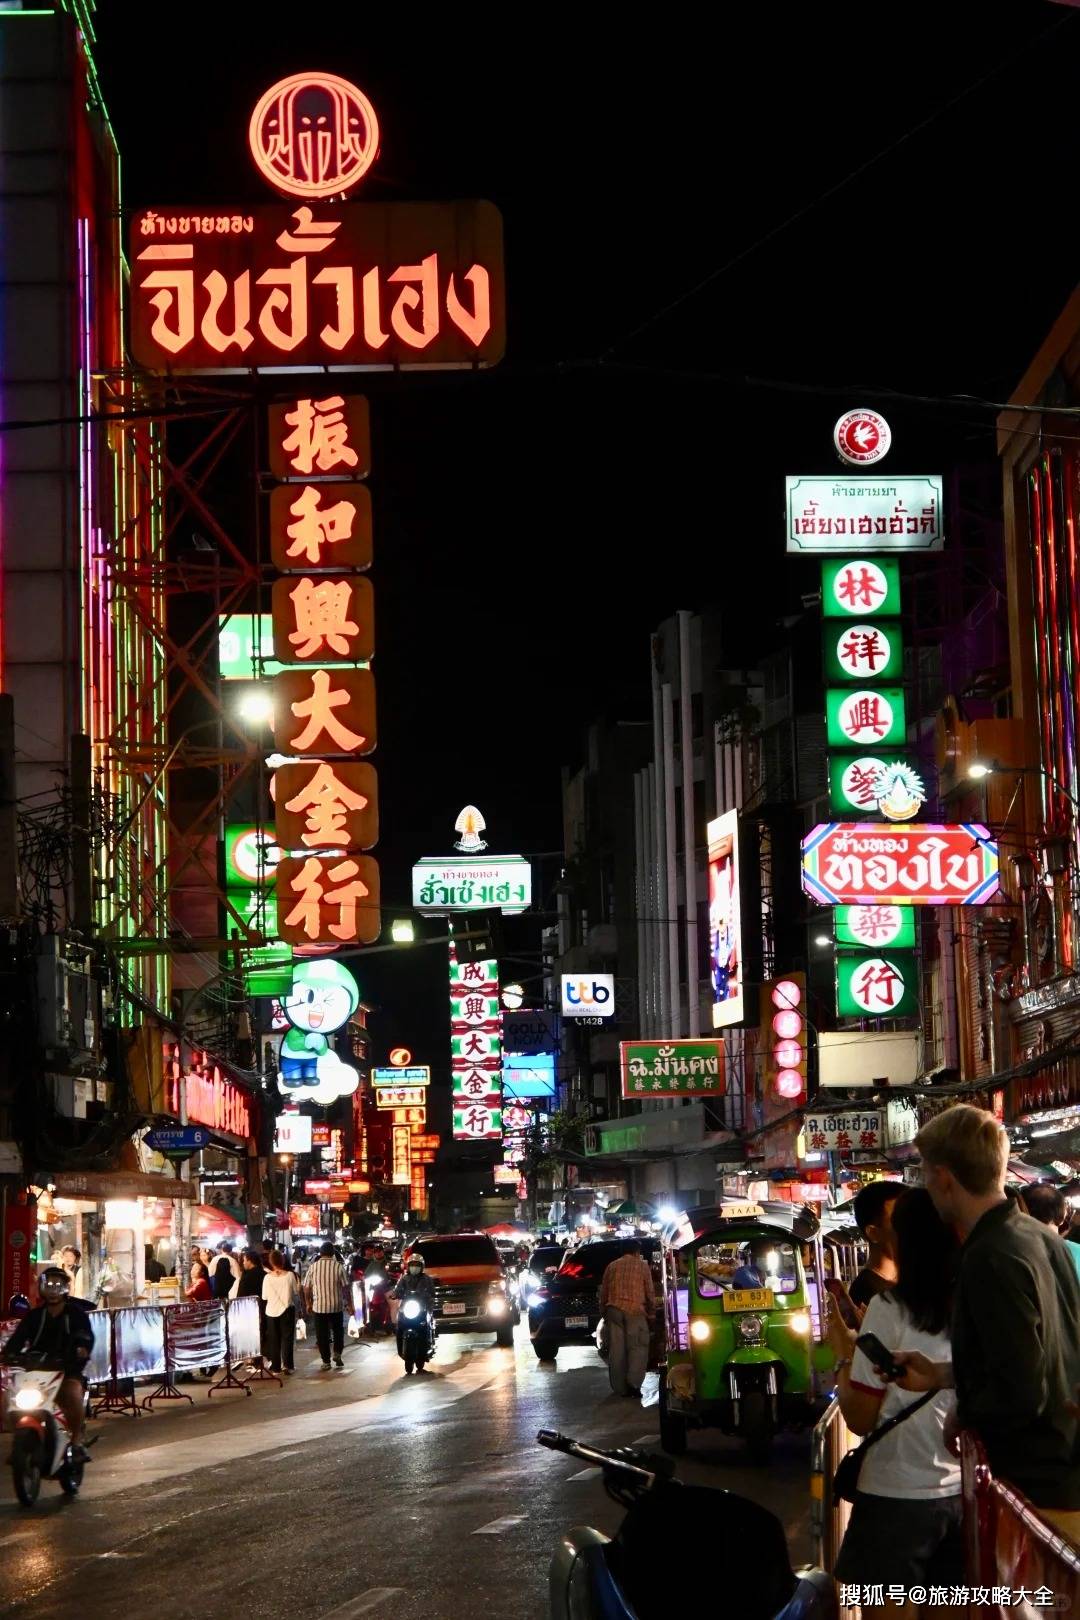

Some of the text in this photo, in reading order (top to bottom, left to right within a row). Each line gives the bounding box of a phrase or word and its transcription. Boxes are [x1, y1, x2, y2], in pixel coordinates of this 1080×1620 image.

[141, 211, 254, 236] ห้างขายทอง
[282, 396, 369, 941] 振和興大金行
[832, 832, 909, 853] ห้างทอง
[566, 981, 610, 1004] ttb
[582, 1017, 603, 1026] 1428
[194, 1131, 202, 1143] 6
[731, 1206, 756, 1215] TAXI
